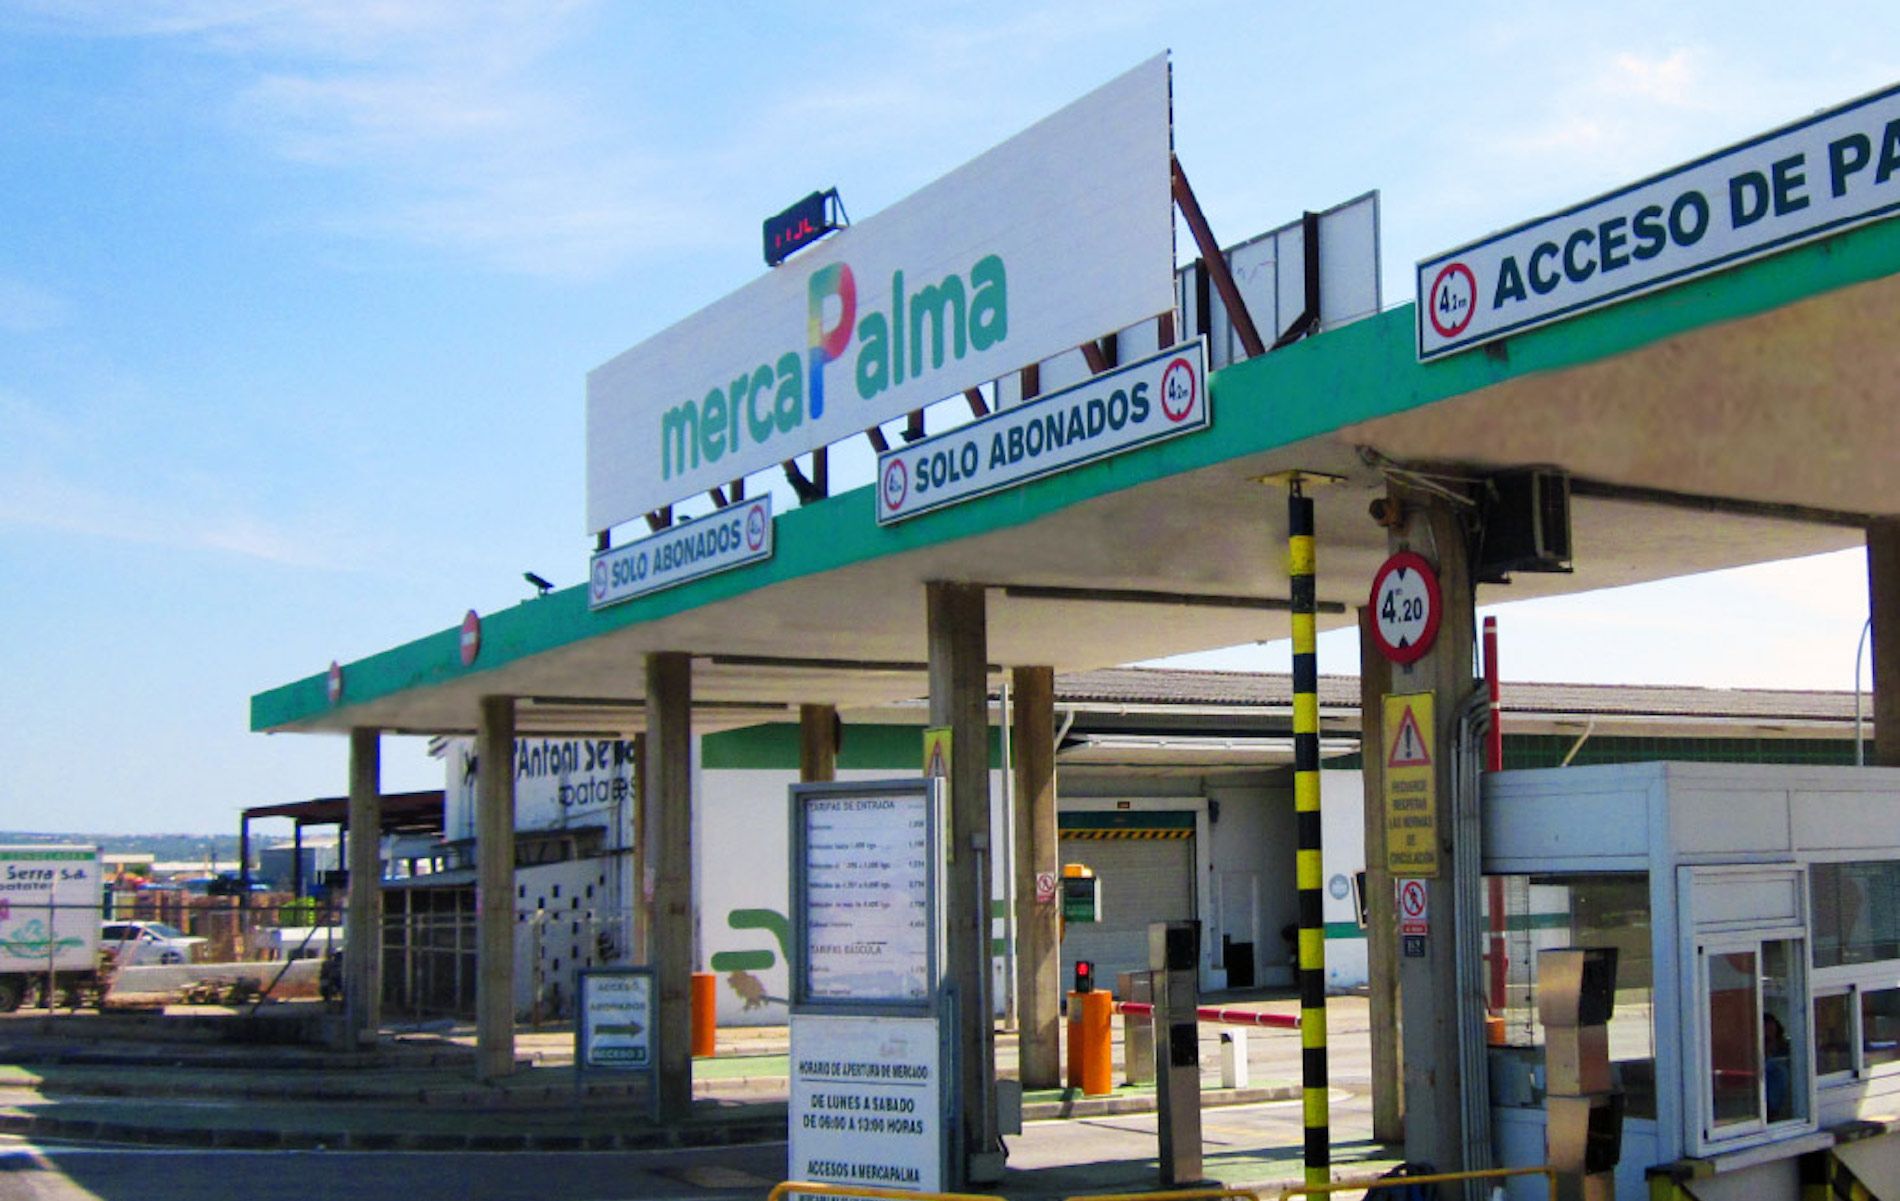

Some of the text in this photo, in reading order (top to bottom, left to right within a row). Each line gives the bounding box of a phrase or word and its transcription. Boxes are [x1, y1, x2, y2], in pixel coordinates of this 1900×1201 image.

[1493, 190, 1710, 309] ACCESO
[1729, 153, 1810, 230] DE
[662, 254, 1008, 481] mercaPalma
[915, 381, 1150, 493] SOLO ABONADOS
[611, 553, 648, 589] SOLO
[653, 519, 742, 577] ABONADOS
[856, 800, 895, 811] ENTRADA
[7, 865, 54, 880] Serra
[799, 1060, 929, 1080] HORARIO DE APERTURA DE MERCADO
[811, 1094, 915, 1113] DE LUNES A SABADO
[803, 1114, 817, 1129] DE
[849, 1117, 855, 1131] A
[886, 1119, 924, 1135] HORAS
[807, 1160, 920, 1183] ACCESOS A MERCAPALMA
